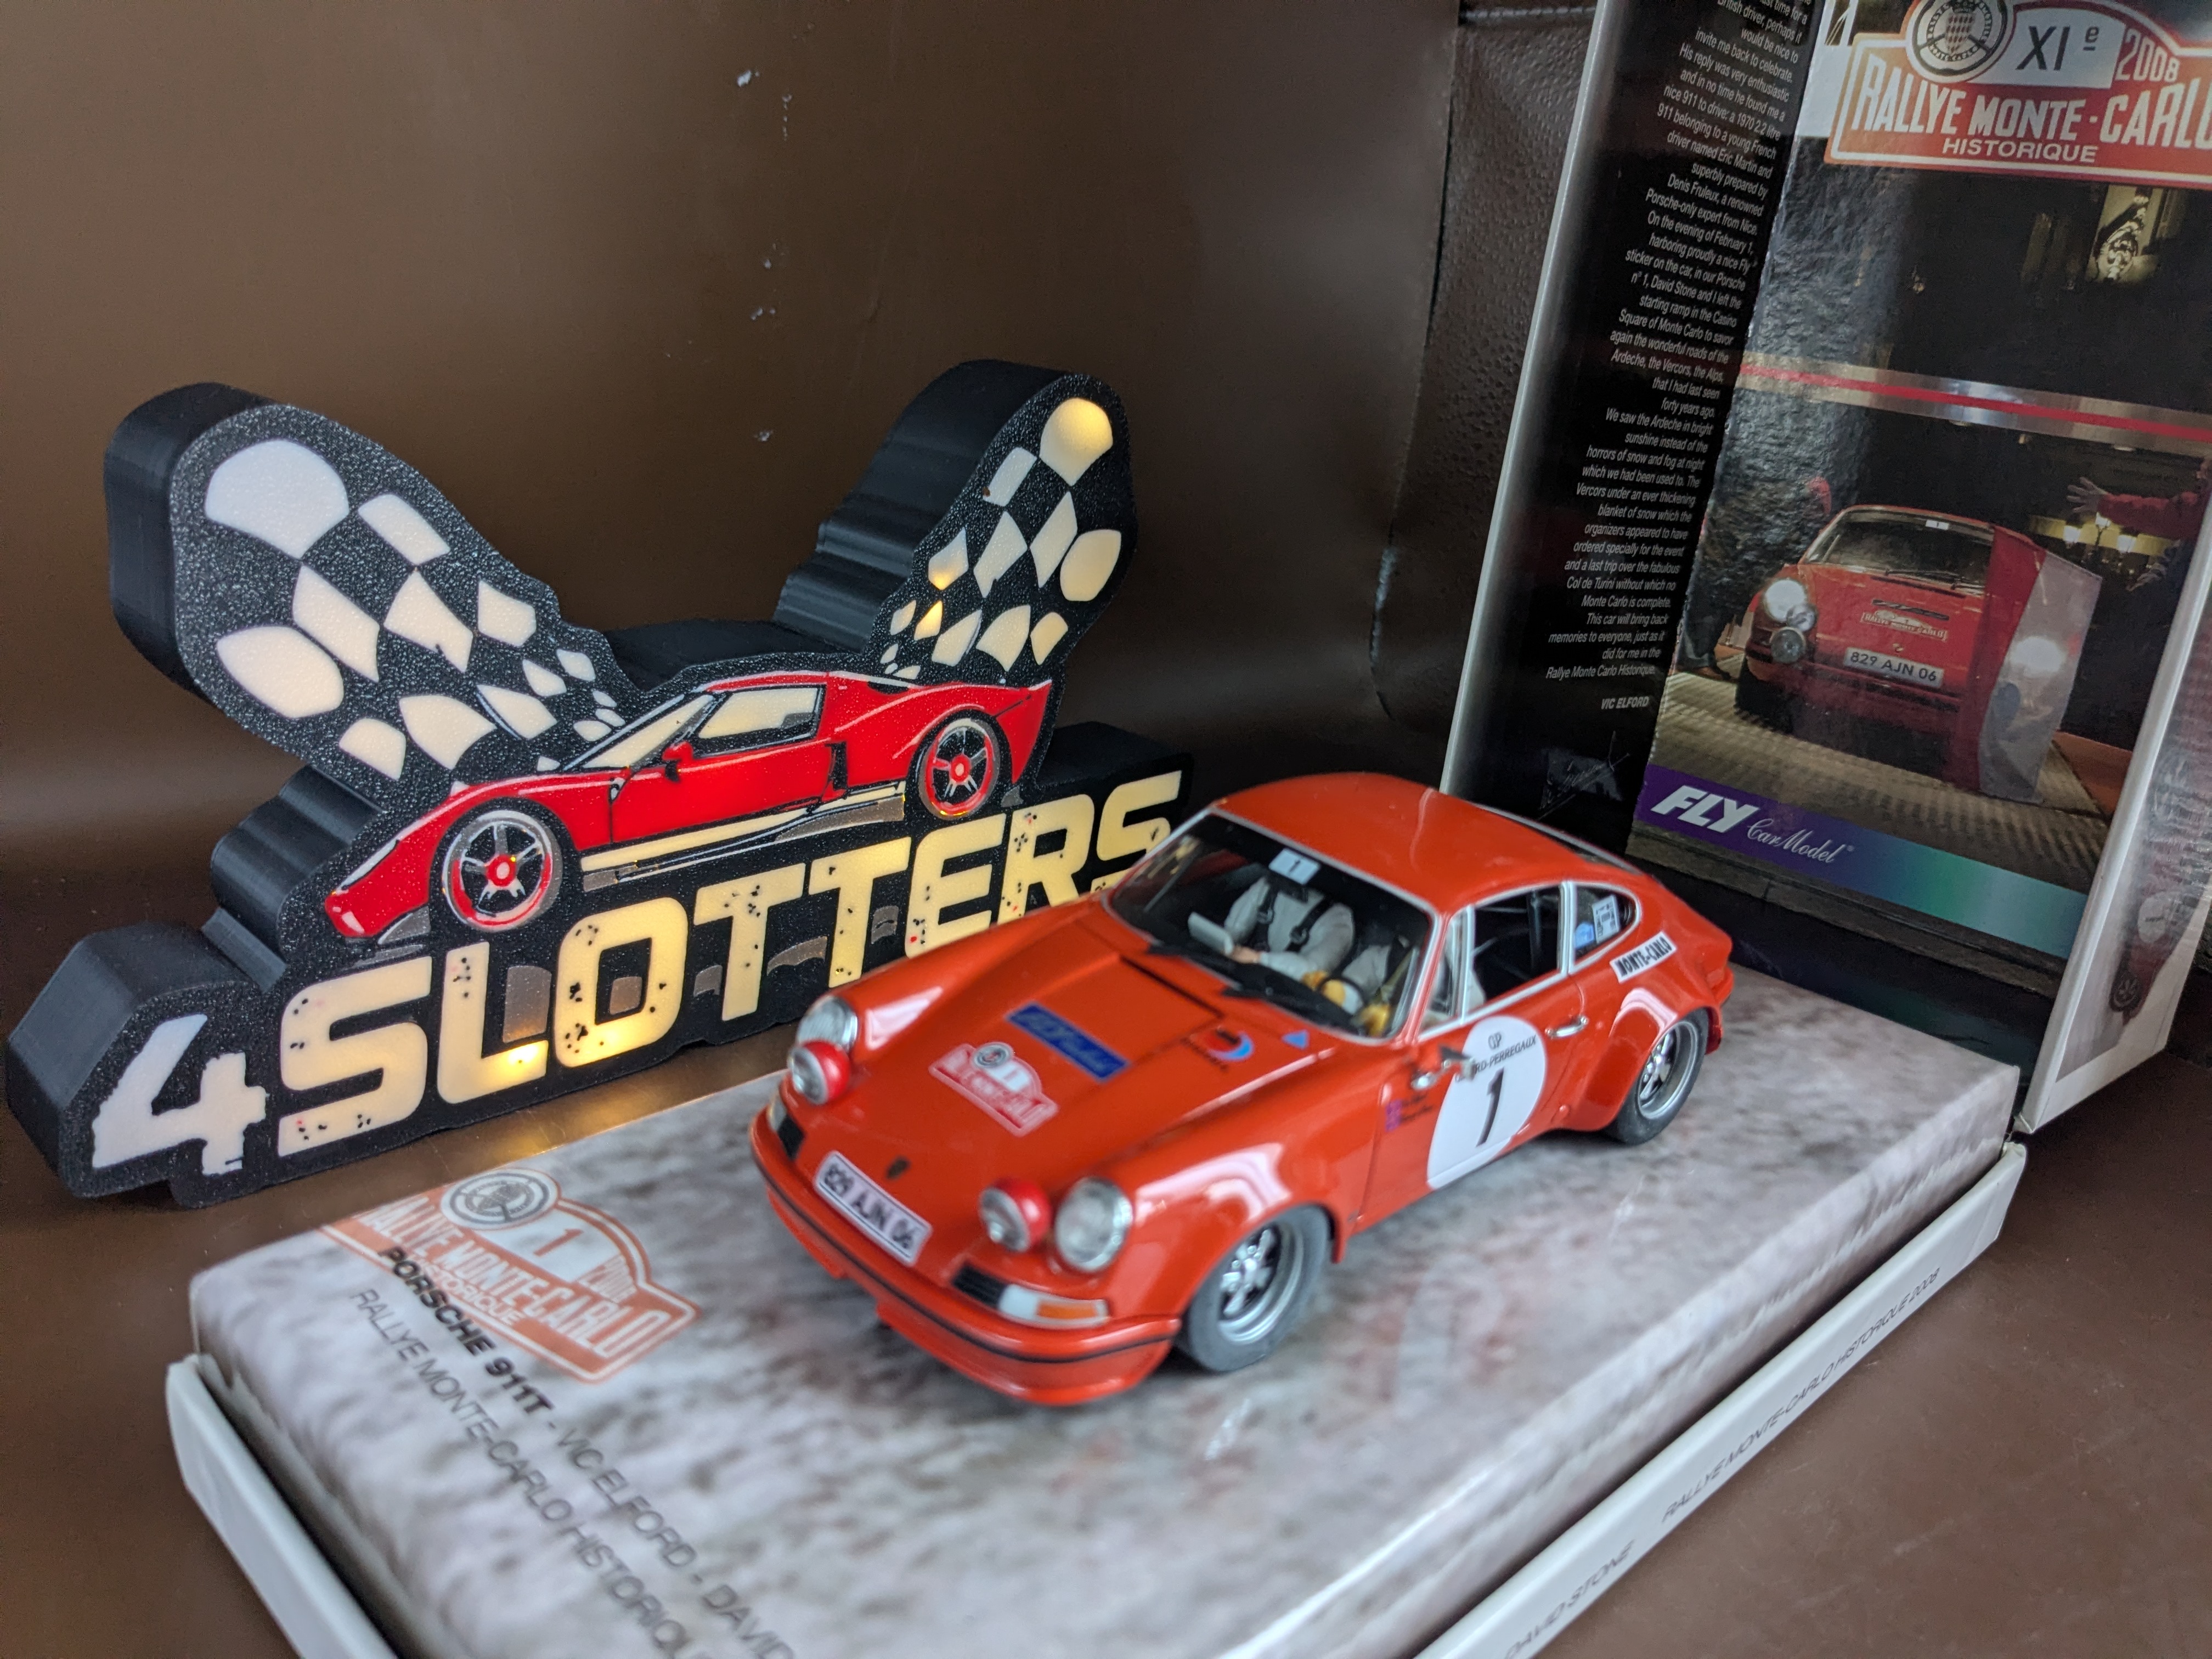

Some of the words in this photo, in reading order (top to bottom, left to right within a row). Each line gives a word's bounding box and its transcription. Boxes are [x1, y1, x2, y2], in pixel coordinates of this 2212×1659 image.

[1743, 5, 1765, 28] driver,
[1765, 18, 1796, 41] perhaps
[1695, 27, 1717, 48] invite
[1717, 40, 1731, 54] me
[1731, 43, 1750, 63] back
[1750, 53, 1759, 67] to
[1759, 60, 1792, 82] celebrate.
[1741, 29, 1764, 47] would
[1763, 36, 1774, 52] be
[1774, 44, 1790, 60] nice
[1790, 50, 1798, 64] to
[2115, 29, 2181, 82] 2008
[1679, 42, 1694, 60] His
[1694, 52, 1714, 72] reply
[1714, 61, 1730, 76] was
[1731, 69, 1748, 86] very
[1747, 76, 1789, 102] enthusiastic
[1851, 53, 1967, 134] RALLYE
[1663, 84, 1681, 101] nice
[1682, 90, 1698, 107] 911
[1697, 97, 1707, 111] to
[1707, 101, 1729, 120] drive:
[1737, 112, 1755, 130] 1970
[1657, 103, 1673, 120] 911
[1673, 109, 1712, 138] belonging
[1712, 126, 1722, 139] to
[1727, 134, 1751, 153] young
[1751, 139, 1776, 159] French
[1942, 138, 2098, 163] HISTORIQUE
[1667, 131, 1691, 149] driver
[1690, 141, 1719, 159] named
[1718, 148, 1733, 165] Eric
[1734, 154, 1757, 173] Martin
[1757, 166, 1774, 179] and
[1667, 173, 1690, 193] Denis
[1690, 182, 1719, 204] Fruleux,
[1728, 197, 1764, 216] renowned
[1691, 163, 1724, 185] superbly
[1723, 175, 1759, 194] prepared
[1757, 184, 1769, 200] by
[1646, 188, 1697, 218] Porsche-only
[1697, 208, 1722, 223] expert
[1722, 213, 1740, 229] from
[1740, 219, 1757, 235] Nice.
[1647, 210, 1661, 225] On
[1661, 216, 1674, 230] the
[1675, 222, 1705, 242] evening
[1705, 230, 1715, 241] of
[1714, 231, 1747, 254] February
[1649, 233, 1687, 257] harboring
[1686, 246, 1716, 265] proudly
[1722, 257, 1739, 269] nice
[1739, 258, 1751, 275] Fly
[1850, 651, 1877, 666] 829
[1881, 659, 1914, 676] AJN
[1918, 668, 1937, 681] 06
[1650, 785, 1760, 833] FLY
[1615, 936, 1672, 977] MONTE-CARLO
[1488, 1032, 1502, 1049] GP
[1476, 1066, 1505, 1148] 1
[533, 1228, 584, 1256] 1
[377, 1246, 497, 1357] PORSCHE
[484, 1357, 554, 1414] 911T
[556, 1430, 604, 1470] VIC
[591, 1469, 698, 1567] ELFORD
[1661, 1458, 1727, 1524] RALLYE
[1724, 1362, 1836, 1468] MONTE-CARLO
[1833, 1292, 1911, 1370] HISTORIQUE
[1908, 1266, 1940, 1304] 2008
[349, 1288, 431, 1362] RALLYE
[411, 1358, 573, 1523] MONTE-CARLO
[554, 1522, 699, 1659] HISTORIQ
